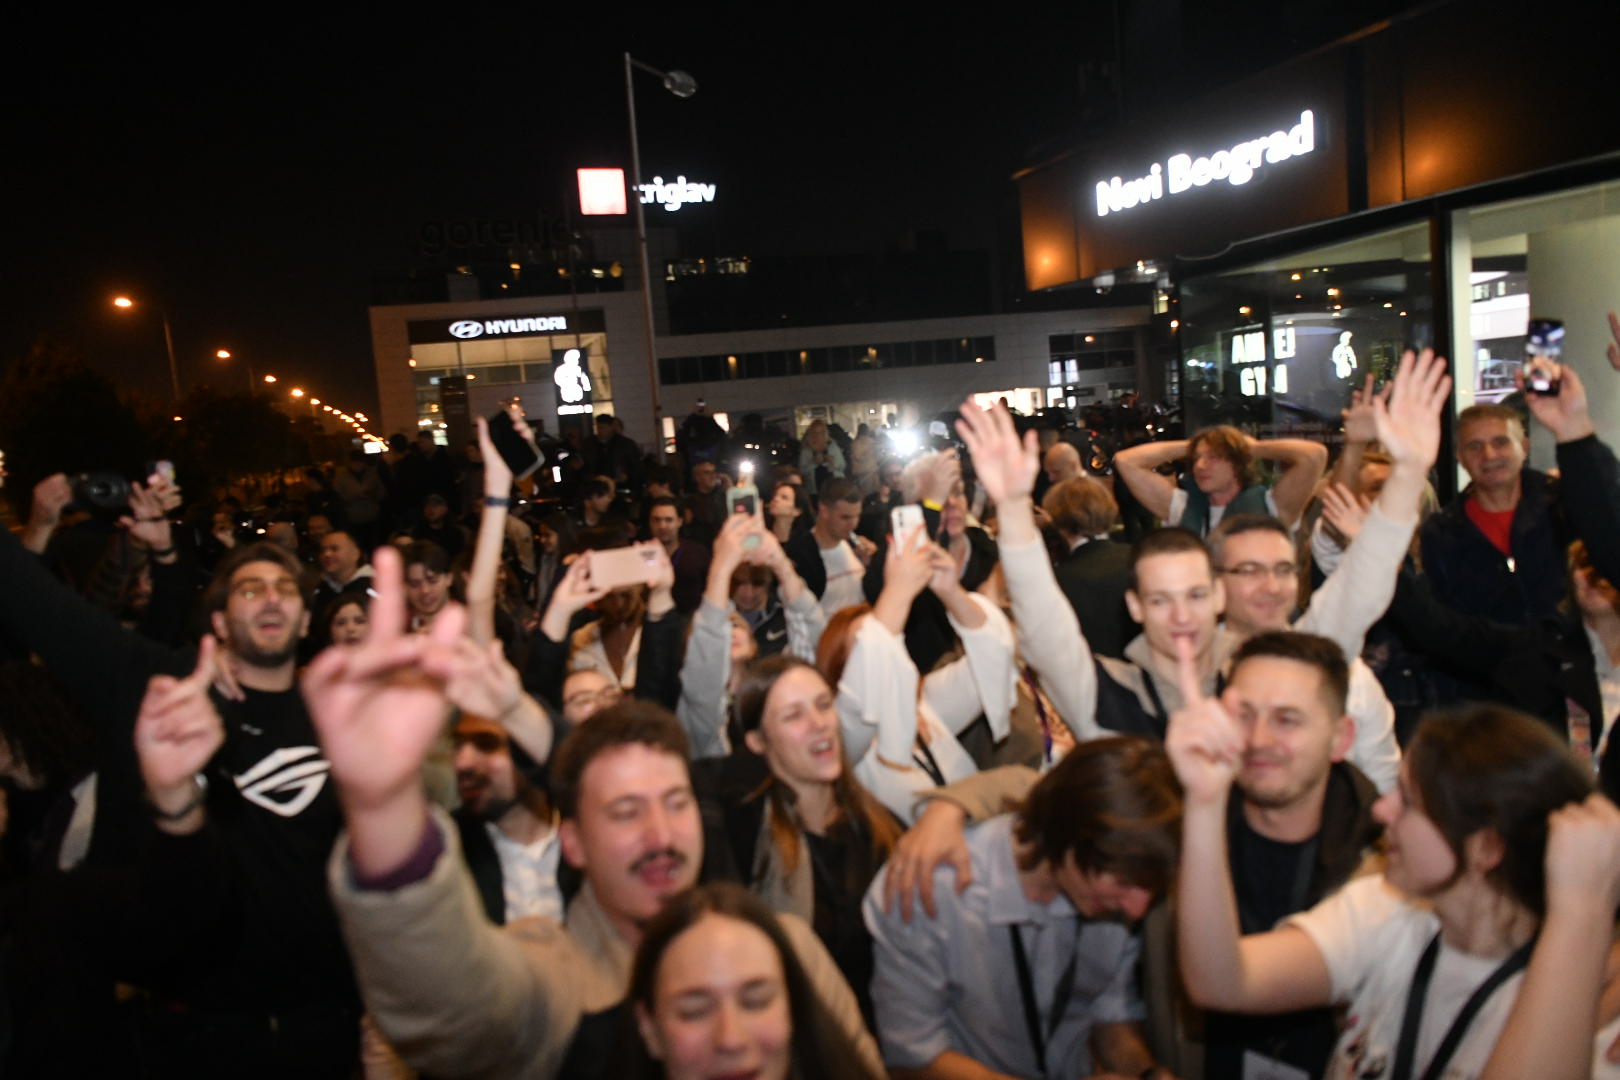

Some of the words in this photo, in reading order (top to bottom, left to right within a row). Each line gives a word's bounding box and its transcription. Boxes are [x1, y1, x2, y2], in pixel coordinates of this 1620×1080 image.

[1095, 162, 1163, 217] Novi
[1167, 109, 1315, 195] Beograd
[484, 316, 568, 335] HYUNDAI
